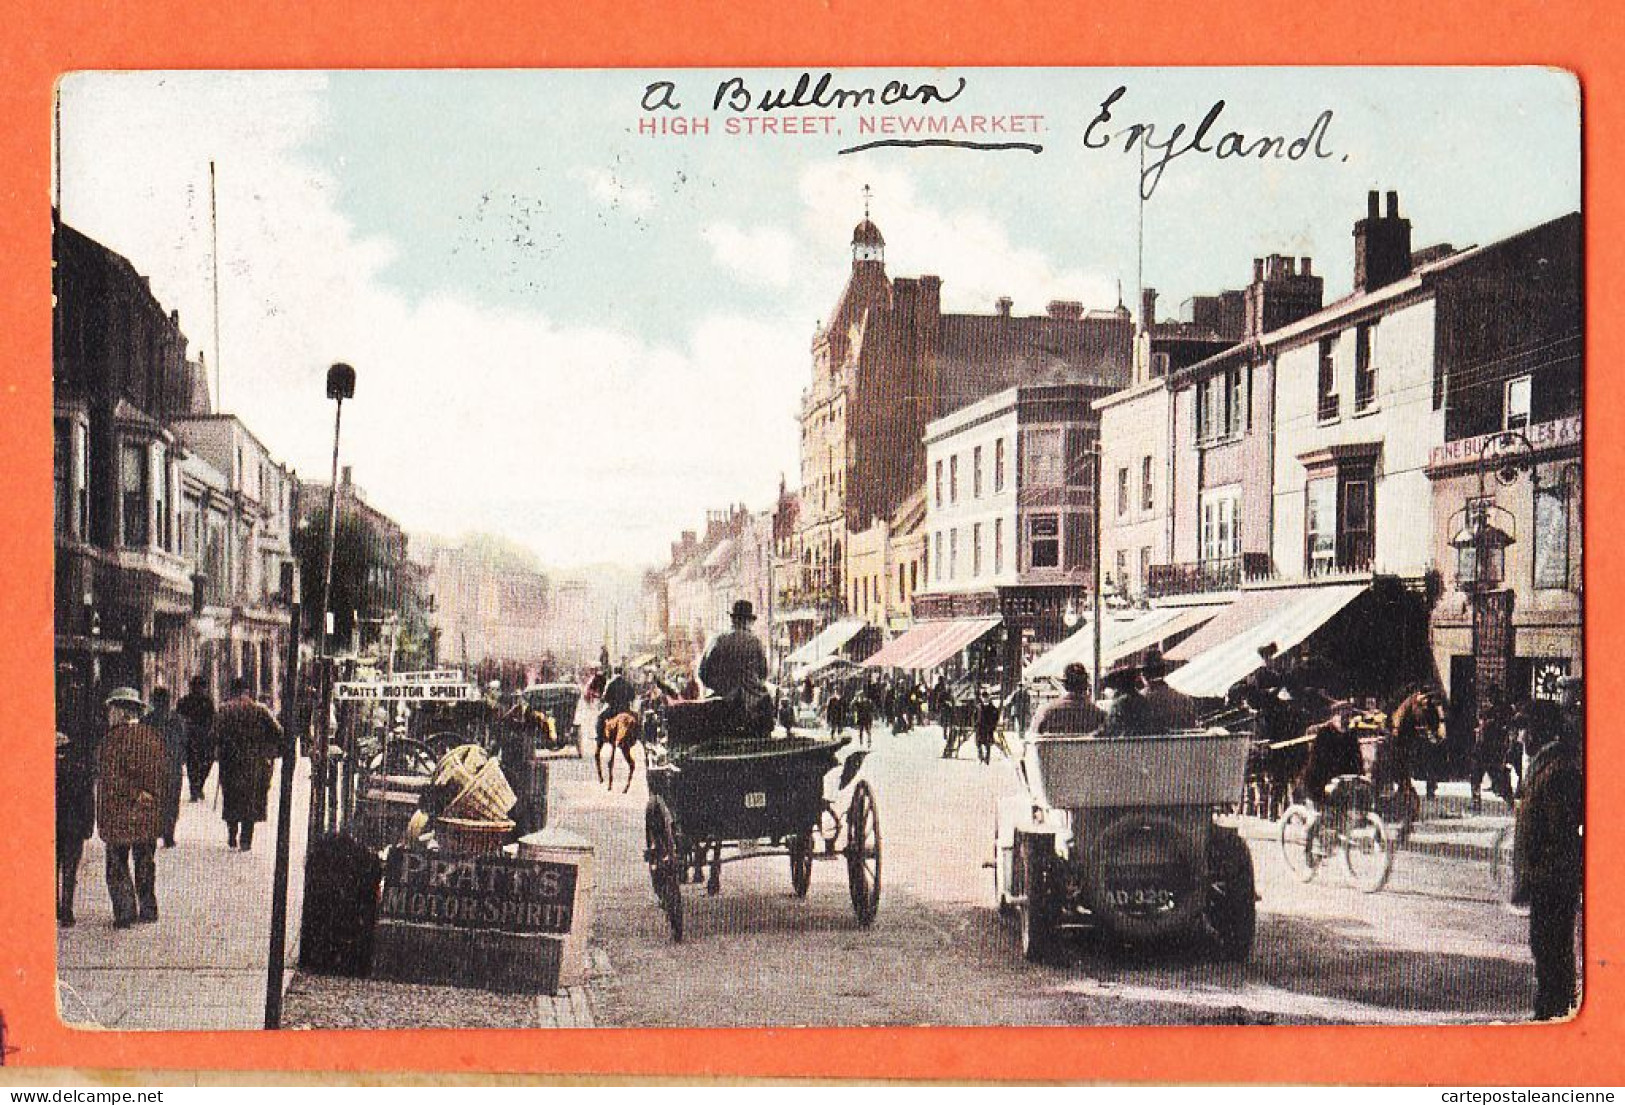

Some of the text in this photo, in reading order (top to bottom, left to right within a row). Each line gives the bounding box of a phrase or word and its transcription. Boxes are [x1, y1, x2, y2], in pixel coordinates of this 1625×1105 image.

[713, 72, 966, 112] Bullman
[382, 684, 425, 699] MOTOR
[428, 685, 468, 699] SPIRIT
[383, 886, 571, 928] MOTOR SPIRIT
